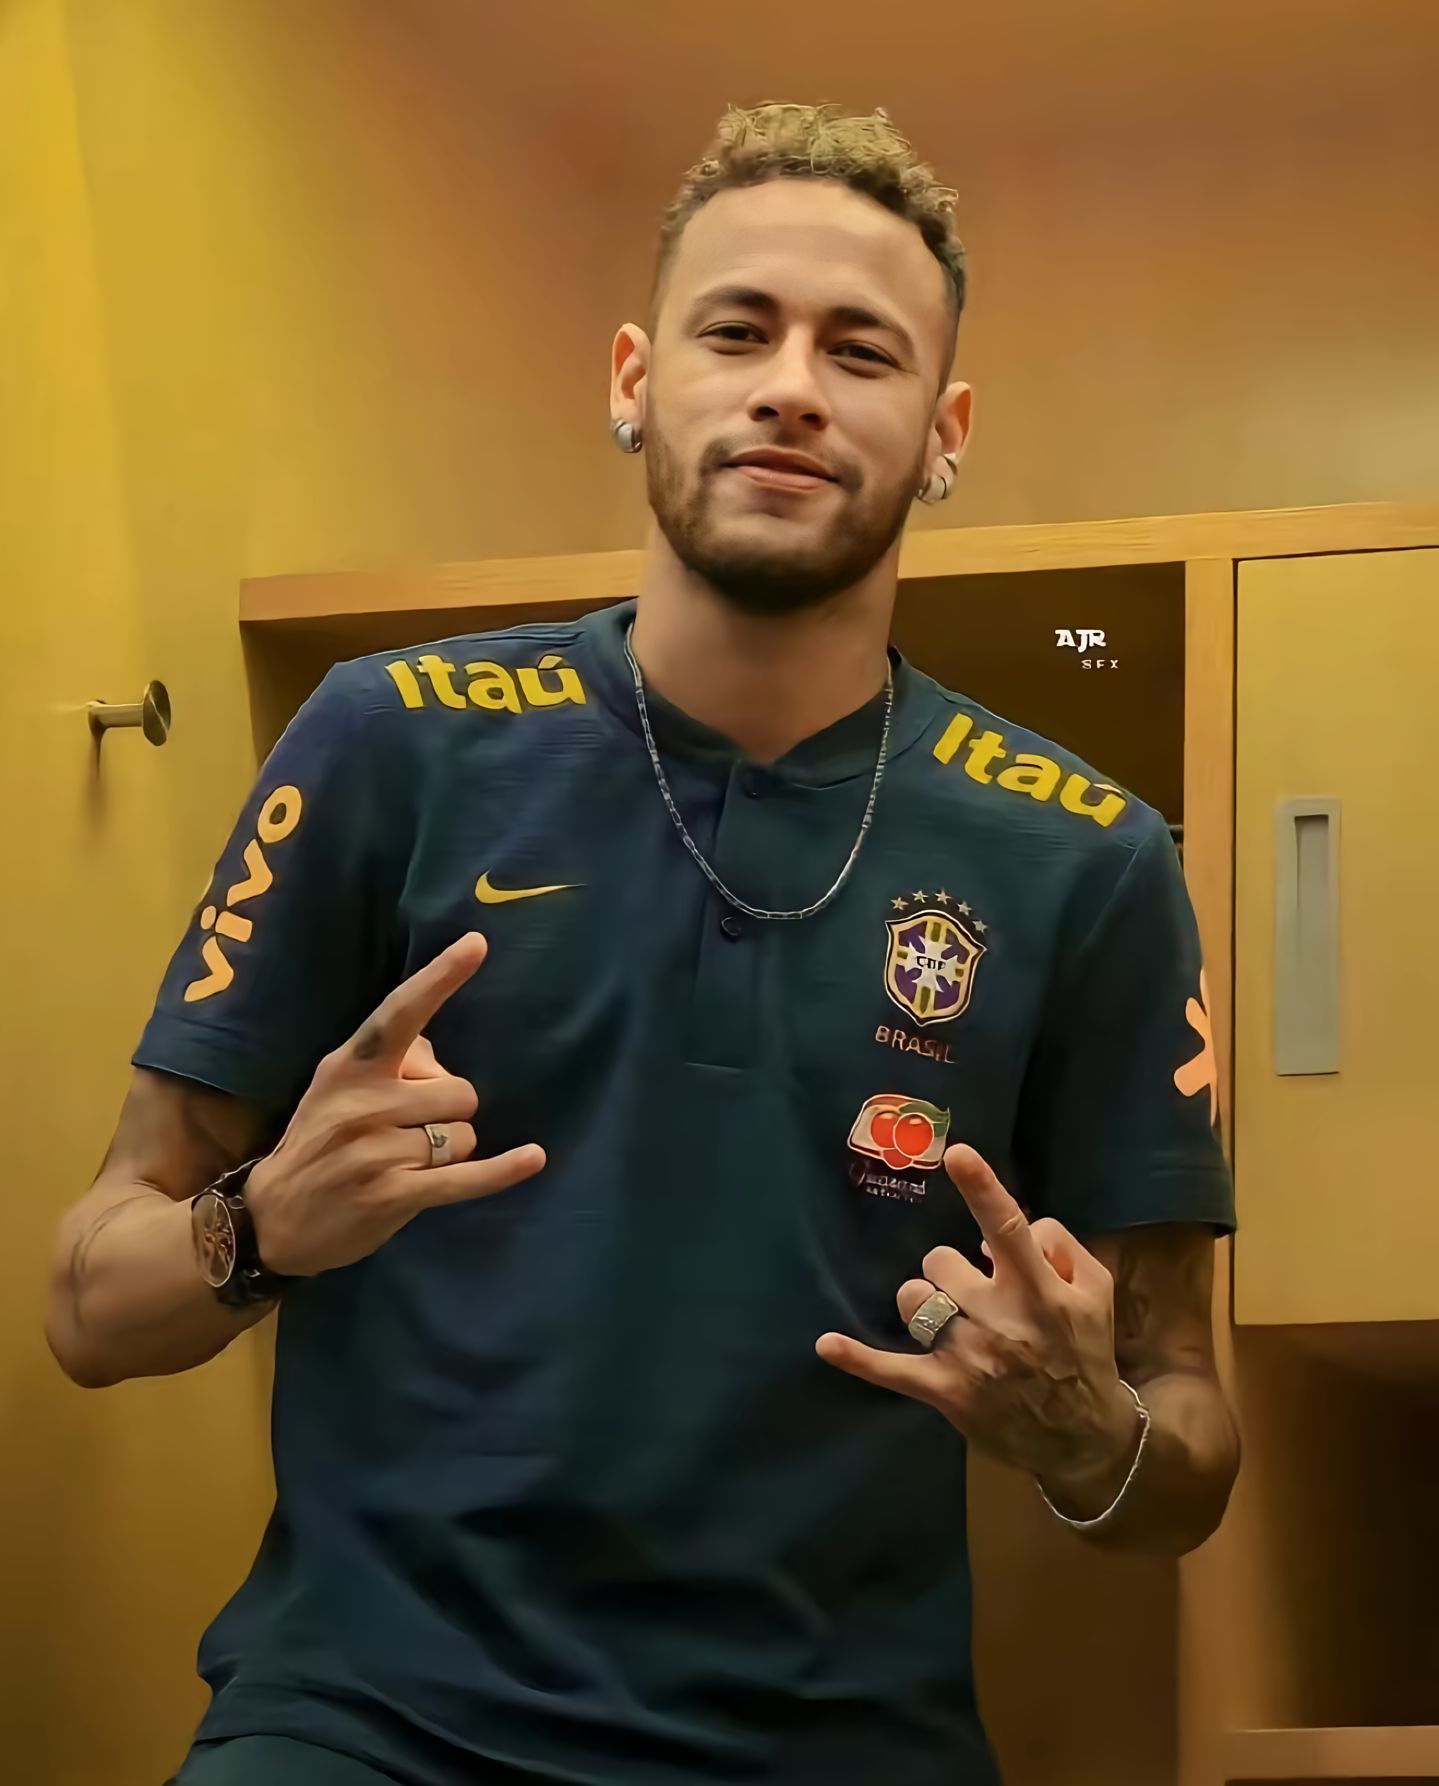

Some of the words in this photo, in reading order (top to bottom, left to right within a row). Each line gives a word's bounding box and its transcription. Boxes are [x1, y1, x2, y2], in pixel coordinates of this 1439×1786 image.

[384, 654, 587, 714] Itaú
[183, 784, 303, 1003] vivo
[875, 1025, 957, 1065] BRASIL
